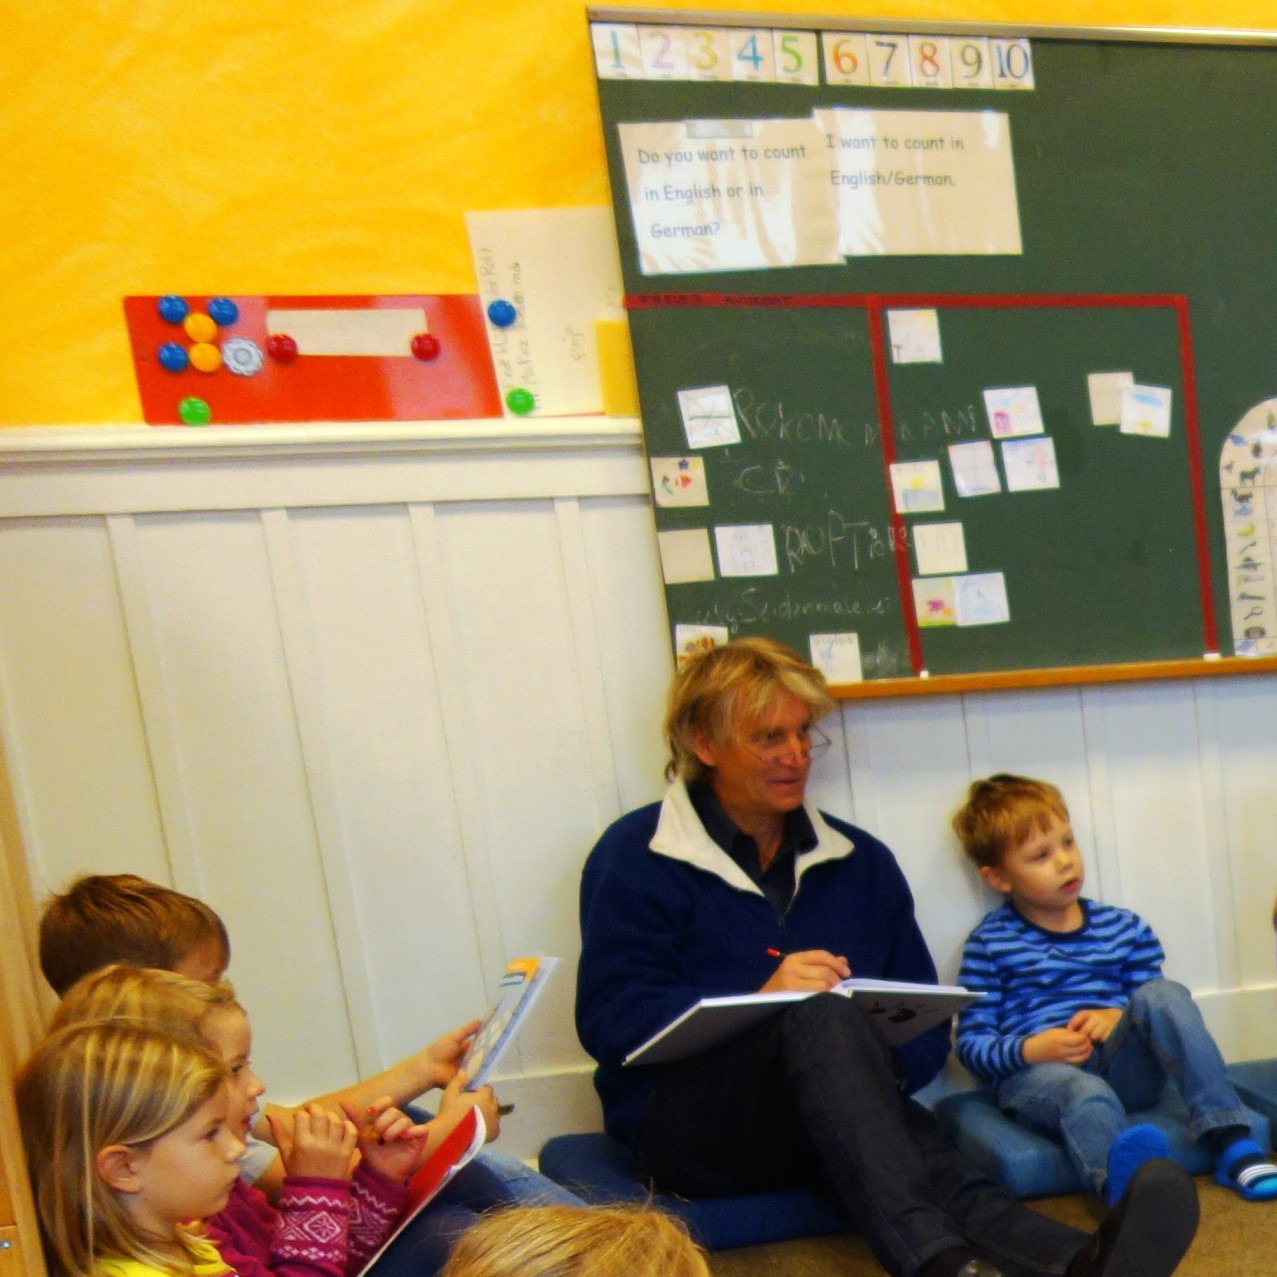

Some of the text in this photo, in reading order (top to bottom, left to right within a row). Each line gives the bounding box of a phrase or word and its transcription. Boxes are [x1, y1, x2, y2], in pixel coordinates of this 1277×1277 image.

[610, 30, 1029, 79] 1 2 3 4 5 6 7 8 9 10
[826, 134, 964, 150] I want to count in
[638, 145, 806, 168] Do you want to count
[830, 170, 957, 189] English/German.
[645, 183, 764, 204] in English or in
[651, 221, 721, 239] German?
